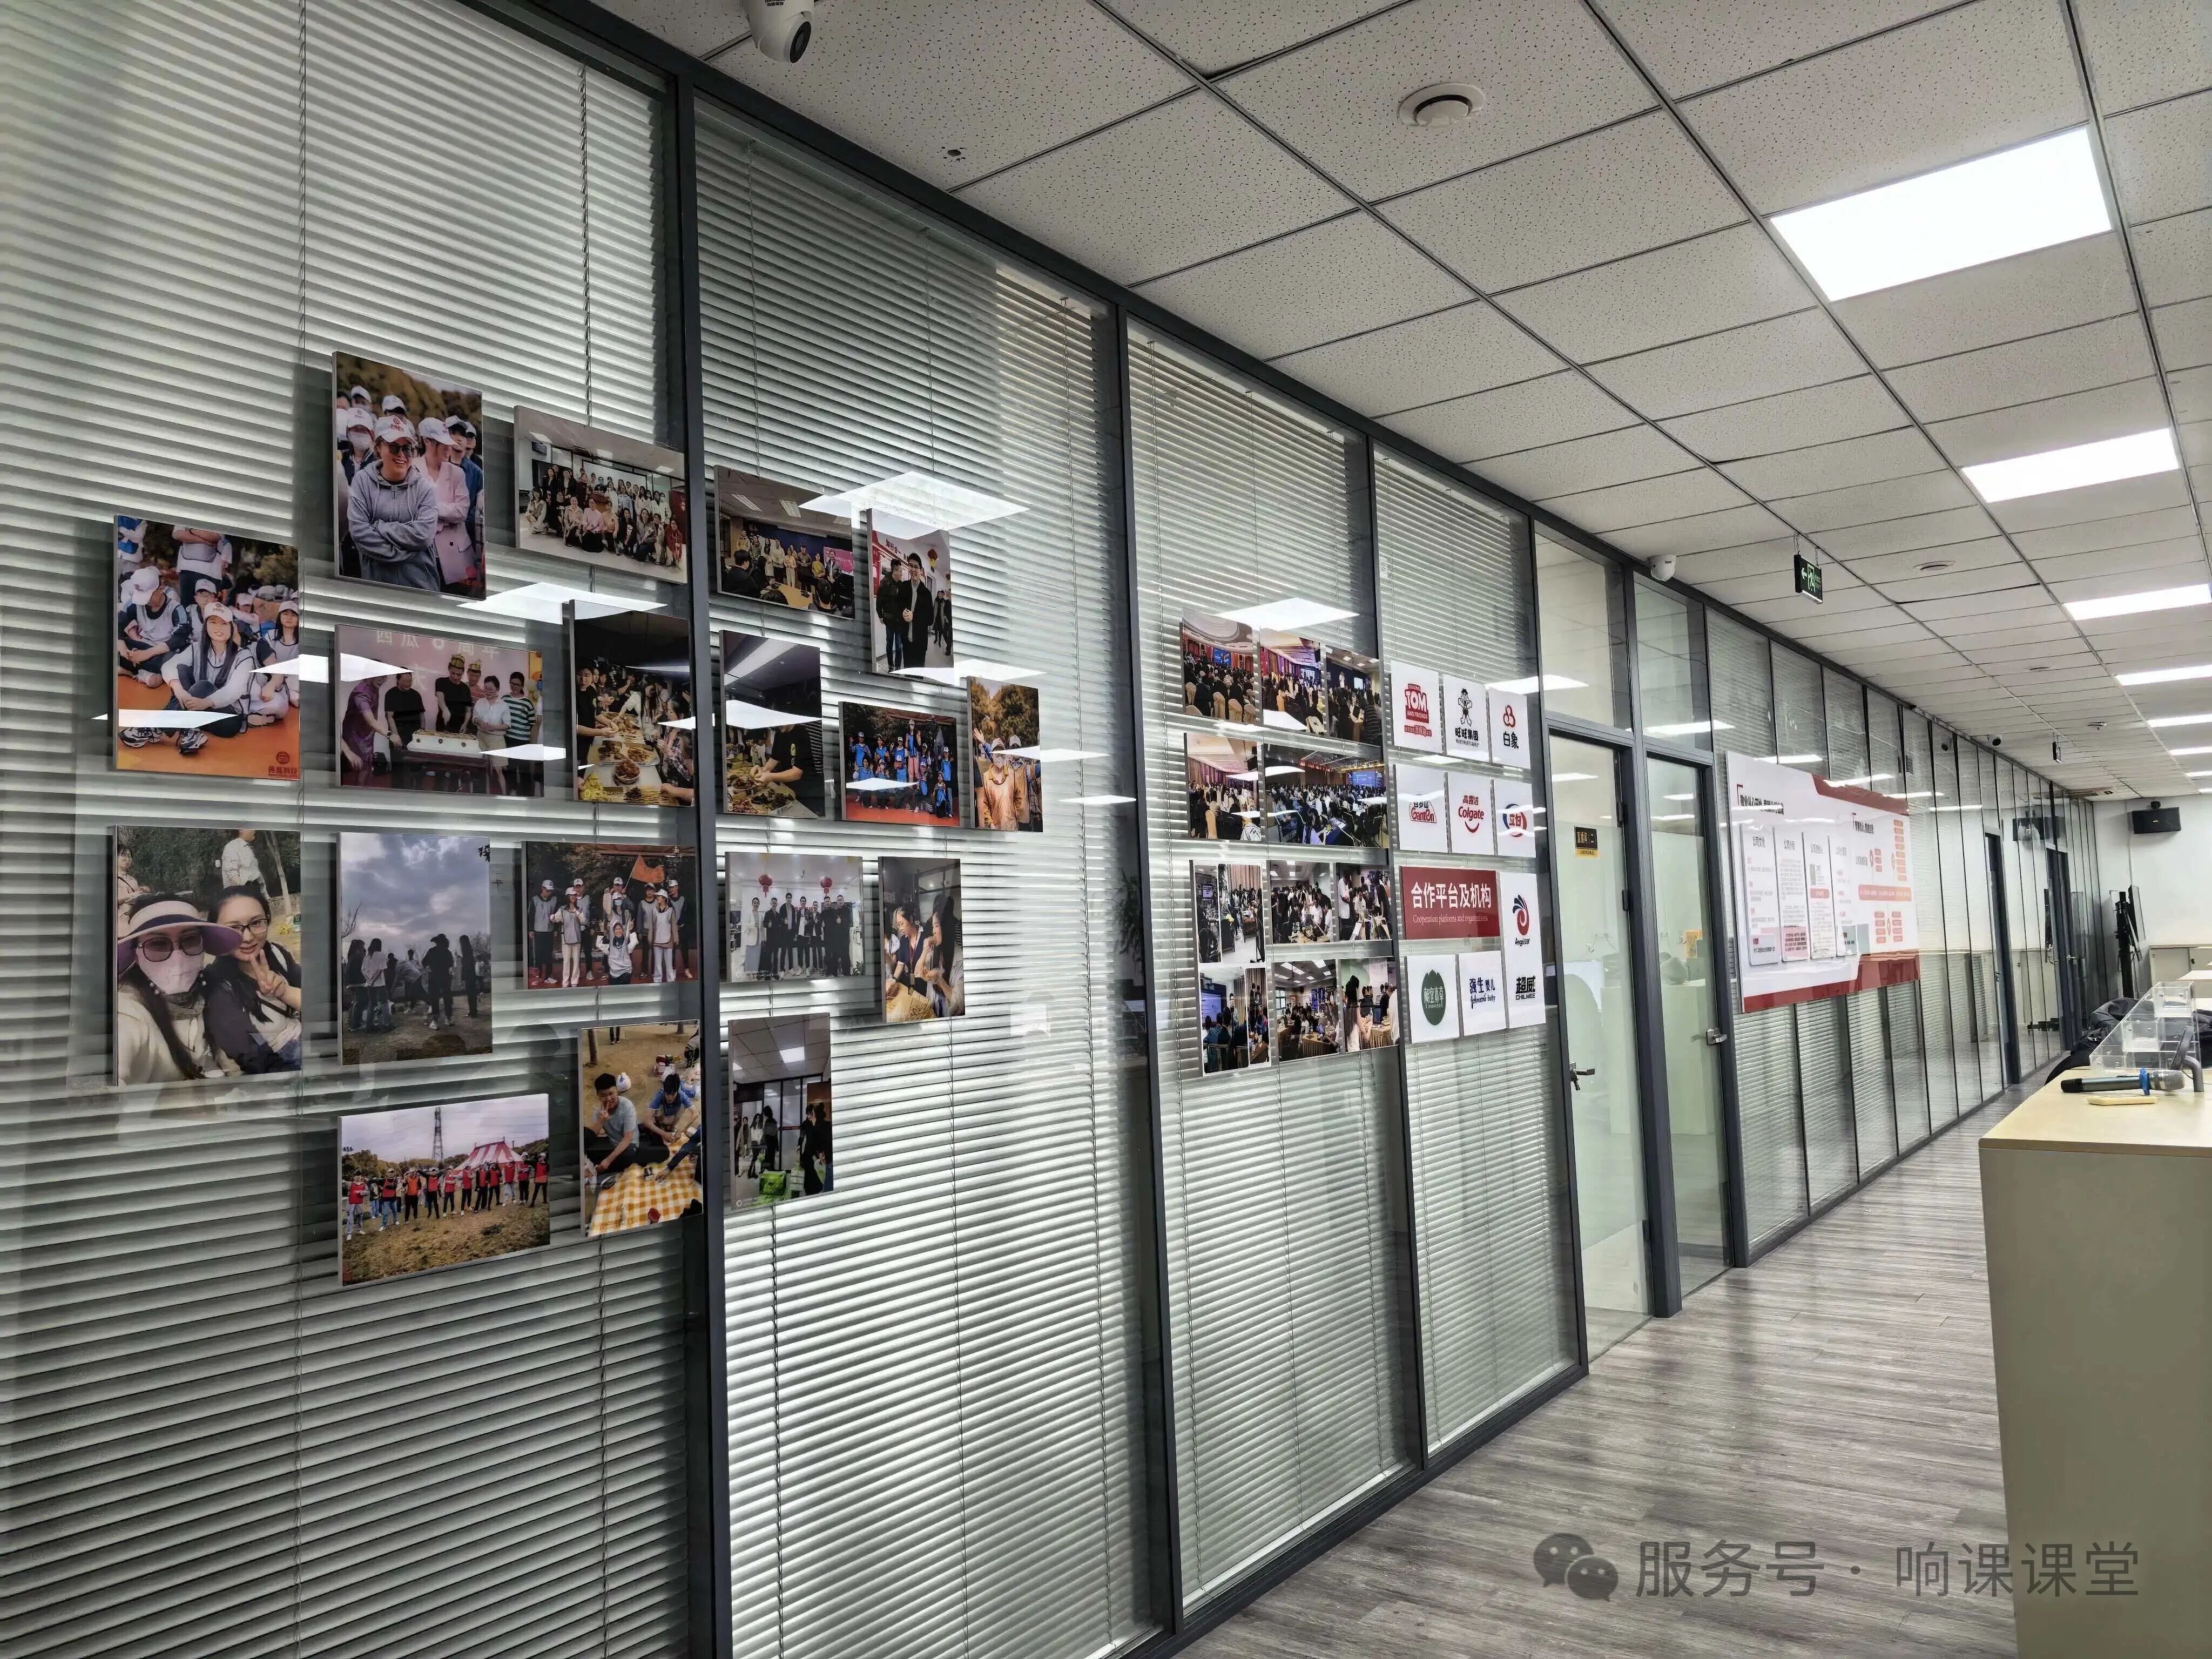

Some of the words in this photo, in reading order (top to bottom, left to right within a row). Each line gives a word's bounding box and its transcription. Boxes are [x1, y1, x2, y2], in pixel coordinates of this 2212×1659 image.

[1405, 691, 1427, 712] TOM
[1455, 727, 1478, 741] 旺旺集团
[1503, 731, 1519, 748] 白象
[1463, 795, 1479, 805] 高露洁
[1458, 806, 1484, 821] Colgate
[1411, 881, 1491, 908] 合作平台及机构
[1413, 914, 1438, 925] Cooperation
[1439, 913, 1457, 925] platforms
[1516, 975, 1535, 994] 超威
